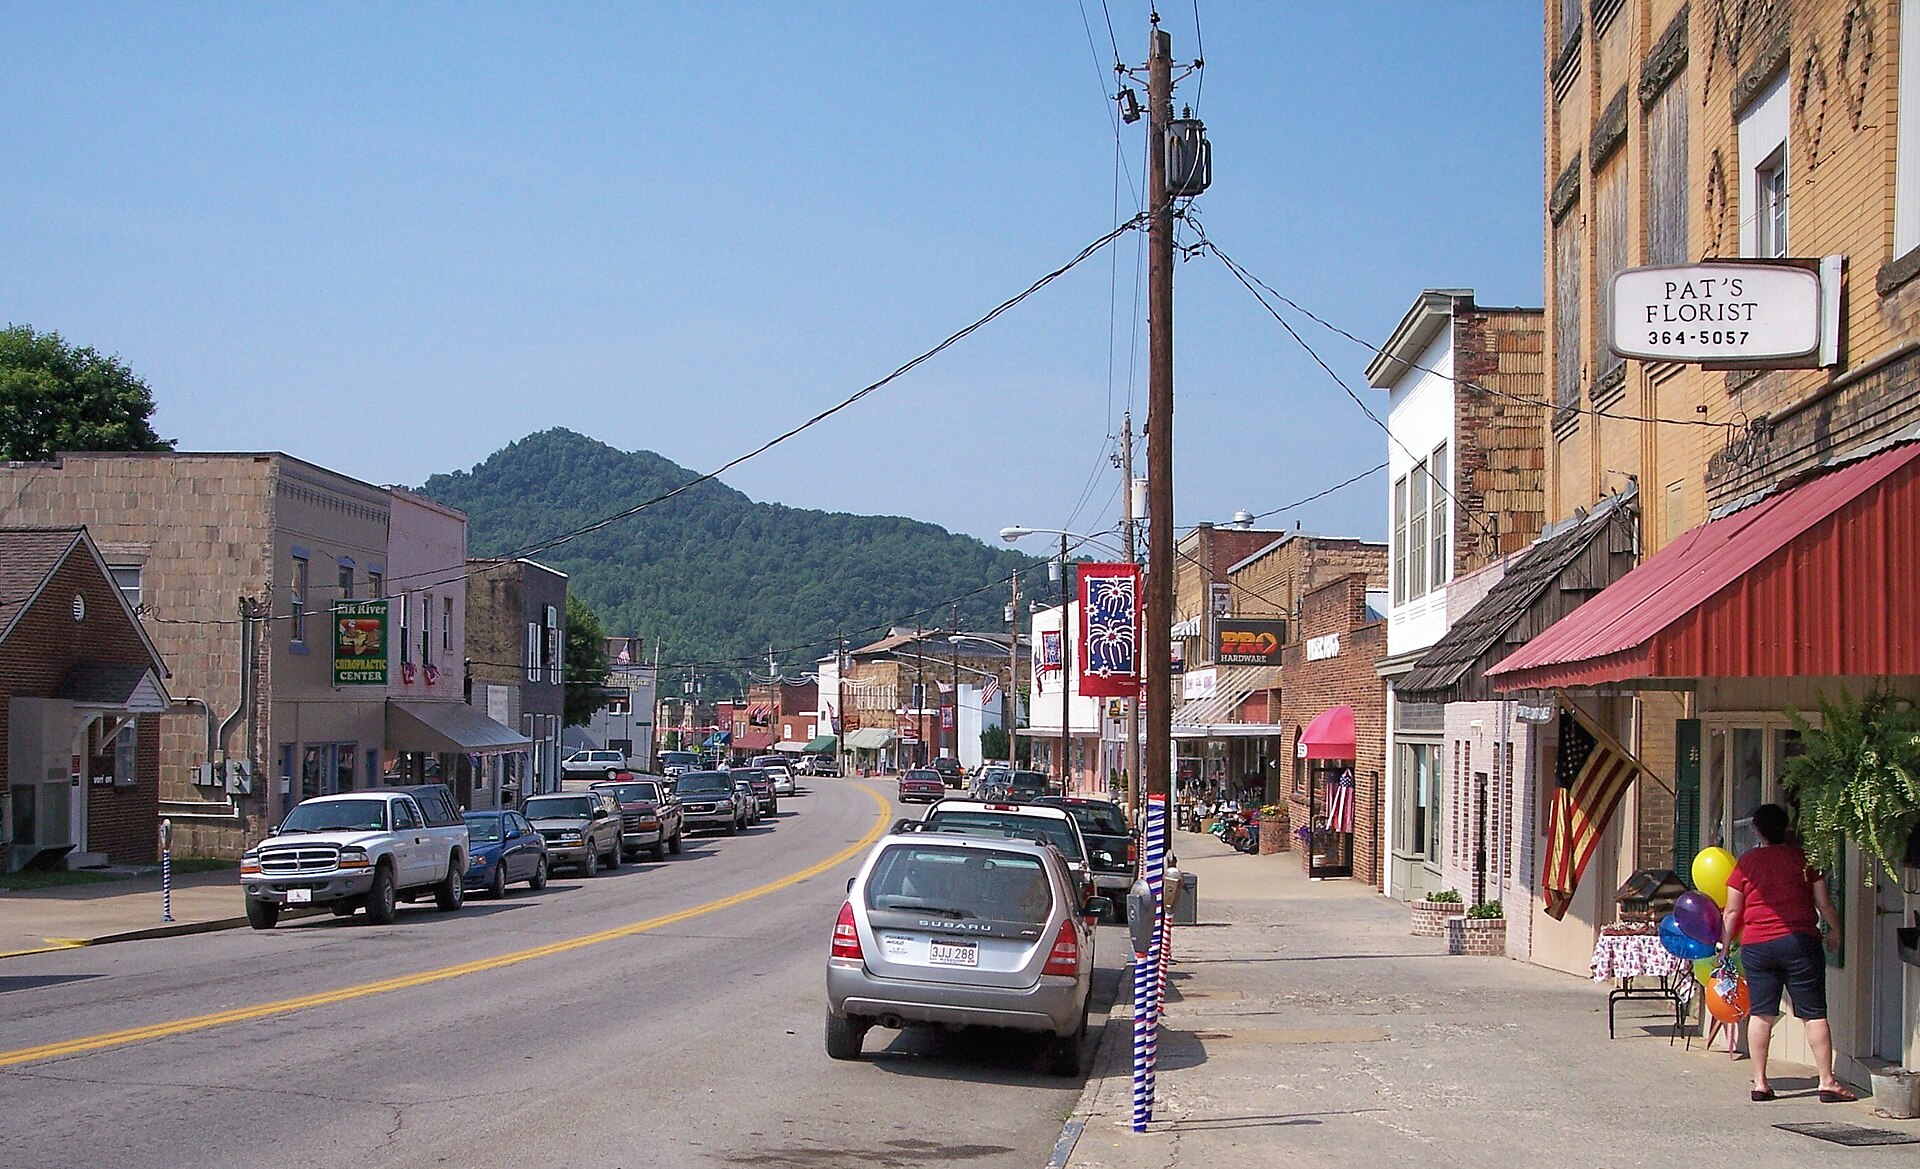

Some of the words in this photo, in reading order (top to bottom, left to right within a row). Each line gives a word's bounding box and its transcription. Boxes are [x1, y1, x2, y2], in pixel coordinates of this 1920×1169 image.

[1664, 277, 1743, 300] PAT'S
[1645, 303, 1758, 323] FLORIST
[1648, 330, 1750, 345] 364-5057
[337, 603, 356, 614] Elk
[357, 603, 387, 614] River
[1221, 631, 1278, 655] PRO
[335, 659, 387, 670] CHIROPRACTIC
[1220, 654, 1267, 663] HARDWARE
[340, 671, 383, 681] CENTER
[93, 773, 112, 784] verion
[918, 919, 992, 931] SUBARU
[932, 946, 952, 958] 3JJ
[954, 948, 974, 960] 288
